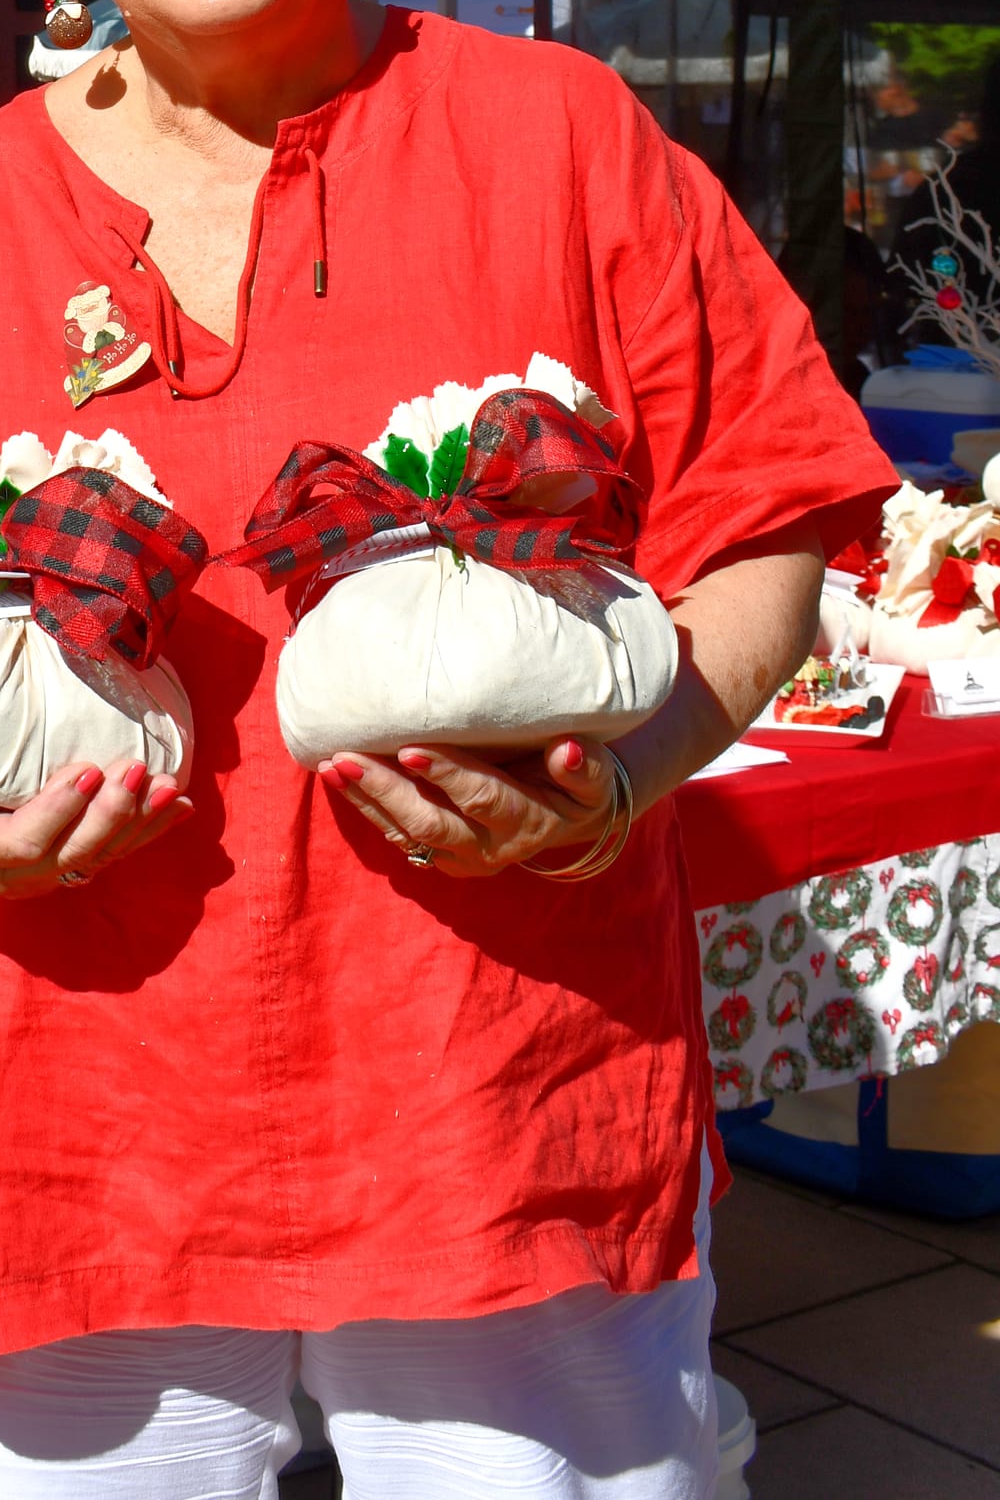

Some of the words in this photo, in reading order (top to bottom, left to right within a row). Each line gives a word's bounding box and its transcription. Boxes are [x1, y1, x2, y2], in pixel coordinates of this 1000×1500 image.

[103, 352, 118, 364] Ho
[114, 342, 128, 355] Ho
[124, 332, 137, 345] Ho
